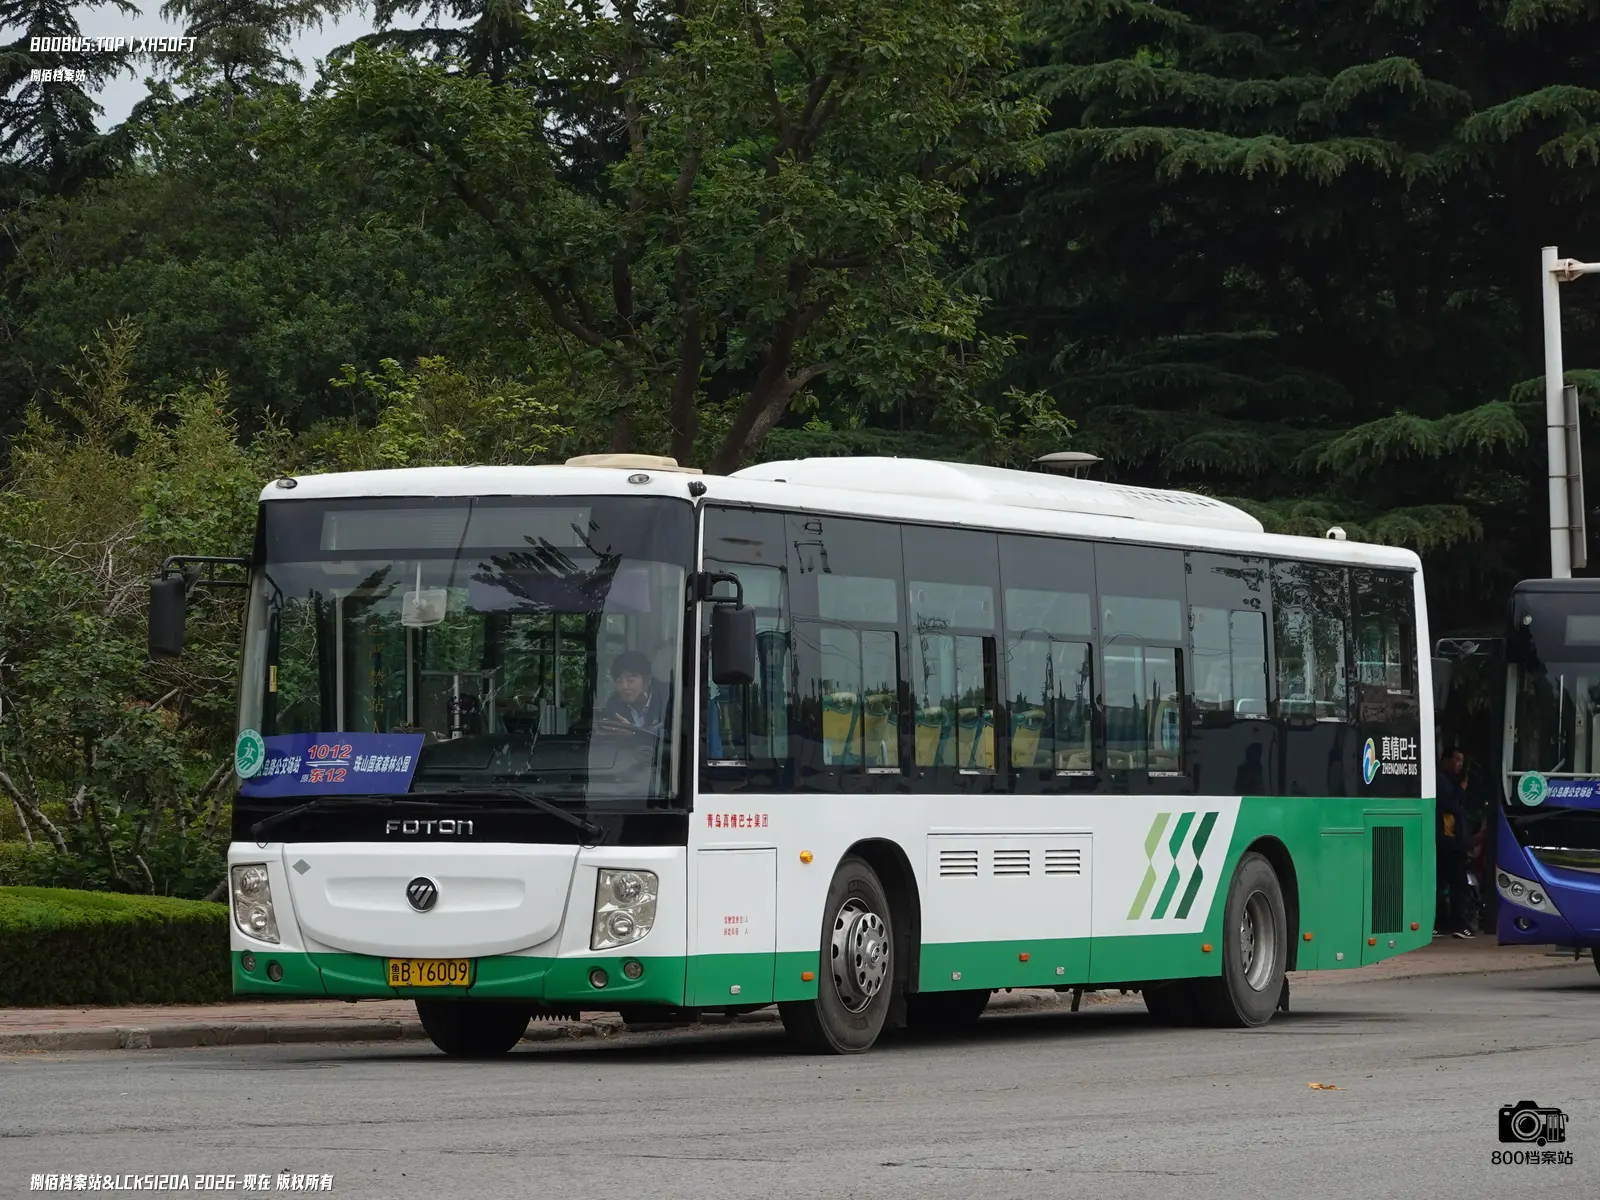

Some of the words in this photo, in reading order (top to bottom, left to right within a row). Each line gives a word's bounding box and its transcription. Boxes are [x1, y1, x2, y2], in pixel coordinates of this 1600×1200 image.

[308, 744, 353, 760] 1012
[1381, 736, 1417, 761] 真情巴士
[353, 754, 412, 773] 珠山国家森林公园
[1381, 762, 1408, 776] ZHENQING
[1408, 763, 1418, 776] BUS
[386, 819, 474, 835] FOTON
[707, 813, 769, 828] 青岛真情巴士集团
